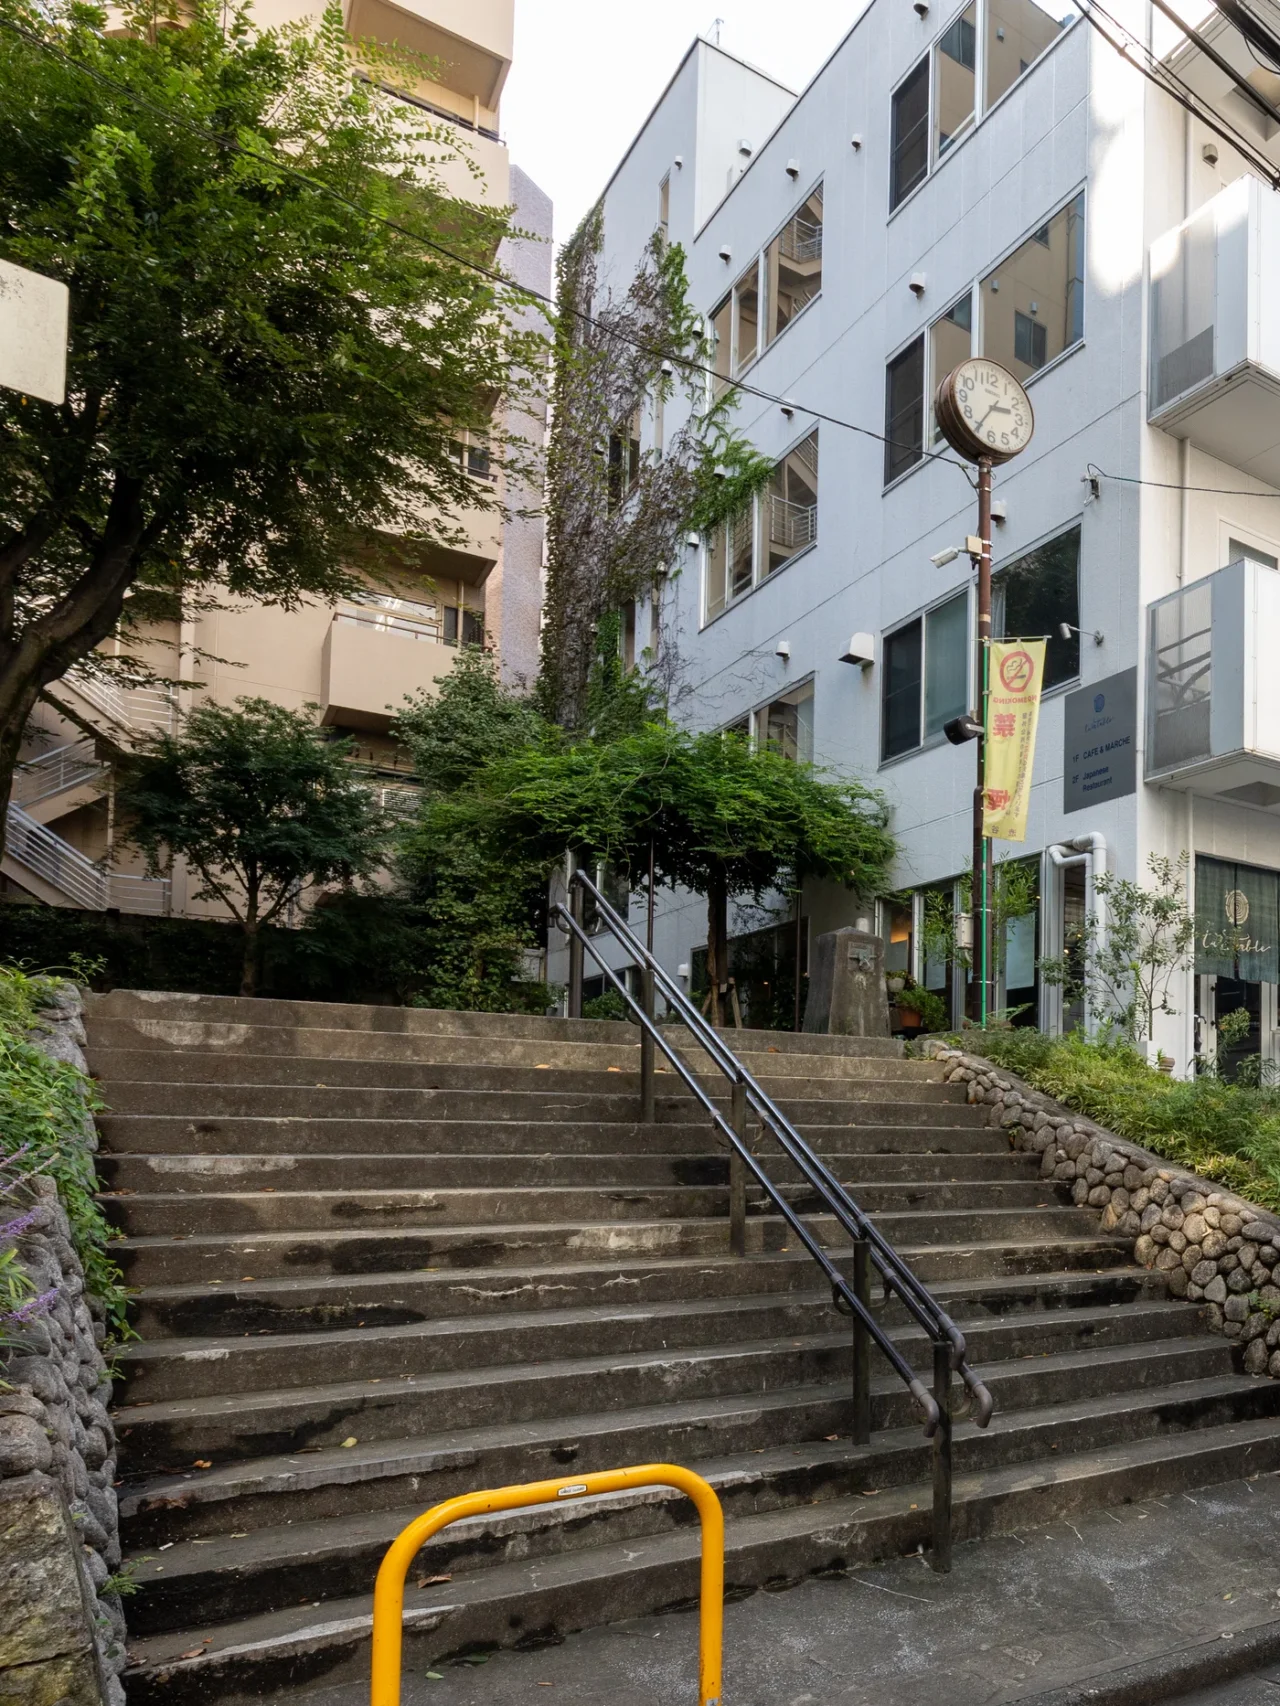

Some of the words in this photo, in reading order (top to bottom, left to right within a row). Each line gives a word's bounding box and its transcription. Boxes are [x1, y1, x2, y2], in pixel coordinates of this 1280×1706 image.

[962, 375, 975, 391] 10
[975, 369, 985, 385] 11
[986, 372, 999, 388] 12
[959, 390, 968, 403] 9
[1011, 397, 1020, 411] 2
[963, 405, 973, 419] 8
[1015, 413, 1024, 427] 3
[986, 430, 996, 444] 6
[1000, 431, 1010, 446] 5
[1010, 427, 1020, 440] 4
[1072, 753, 1080, 765] 1F
[1082, 746, 1099, 761] CAFE
[1105, 735, 1131, 752] MARCHE
[1072, 774, 1080, 785] 2F
[1082, 765, 1110, 781] Japanese
[1082, 775, 1113, 793] Restaurant
